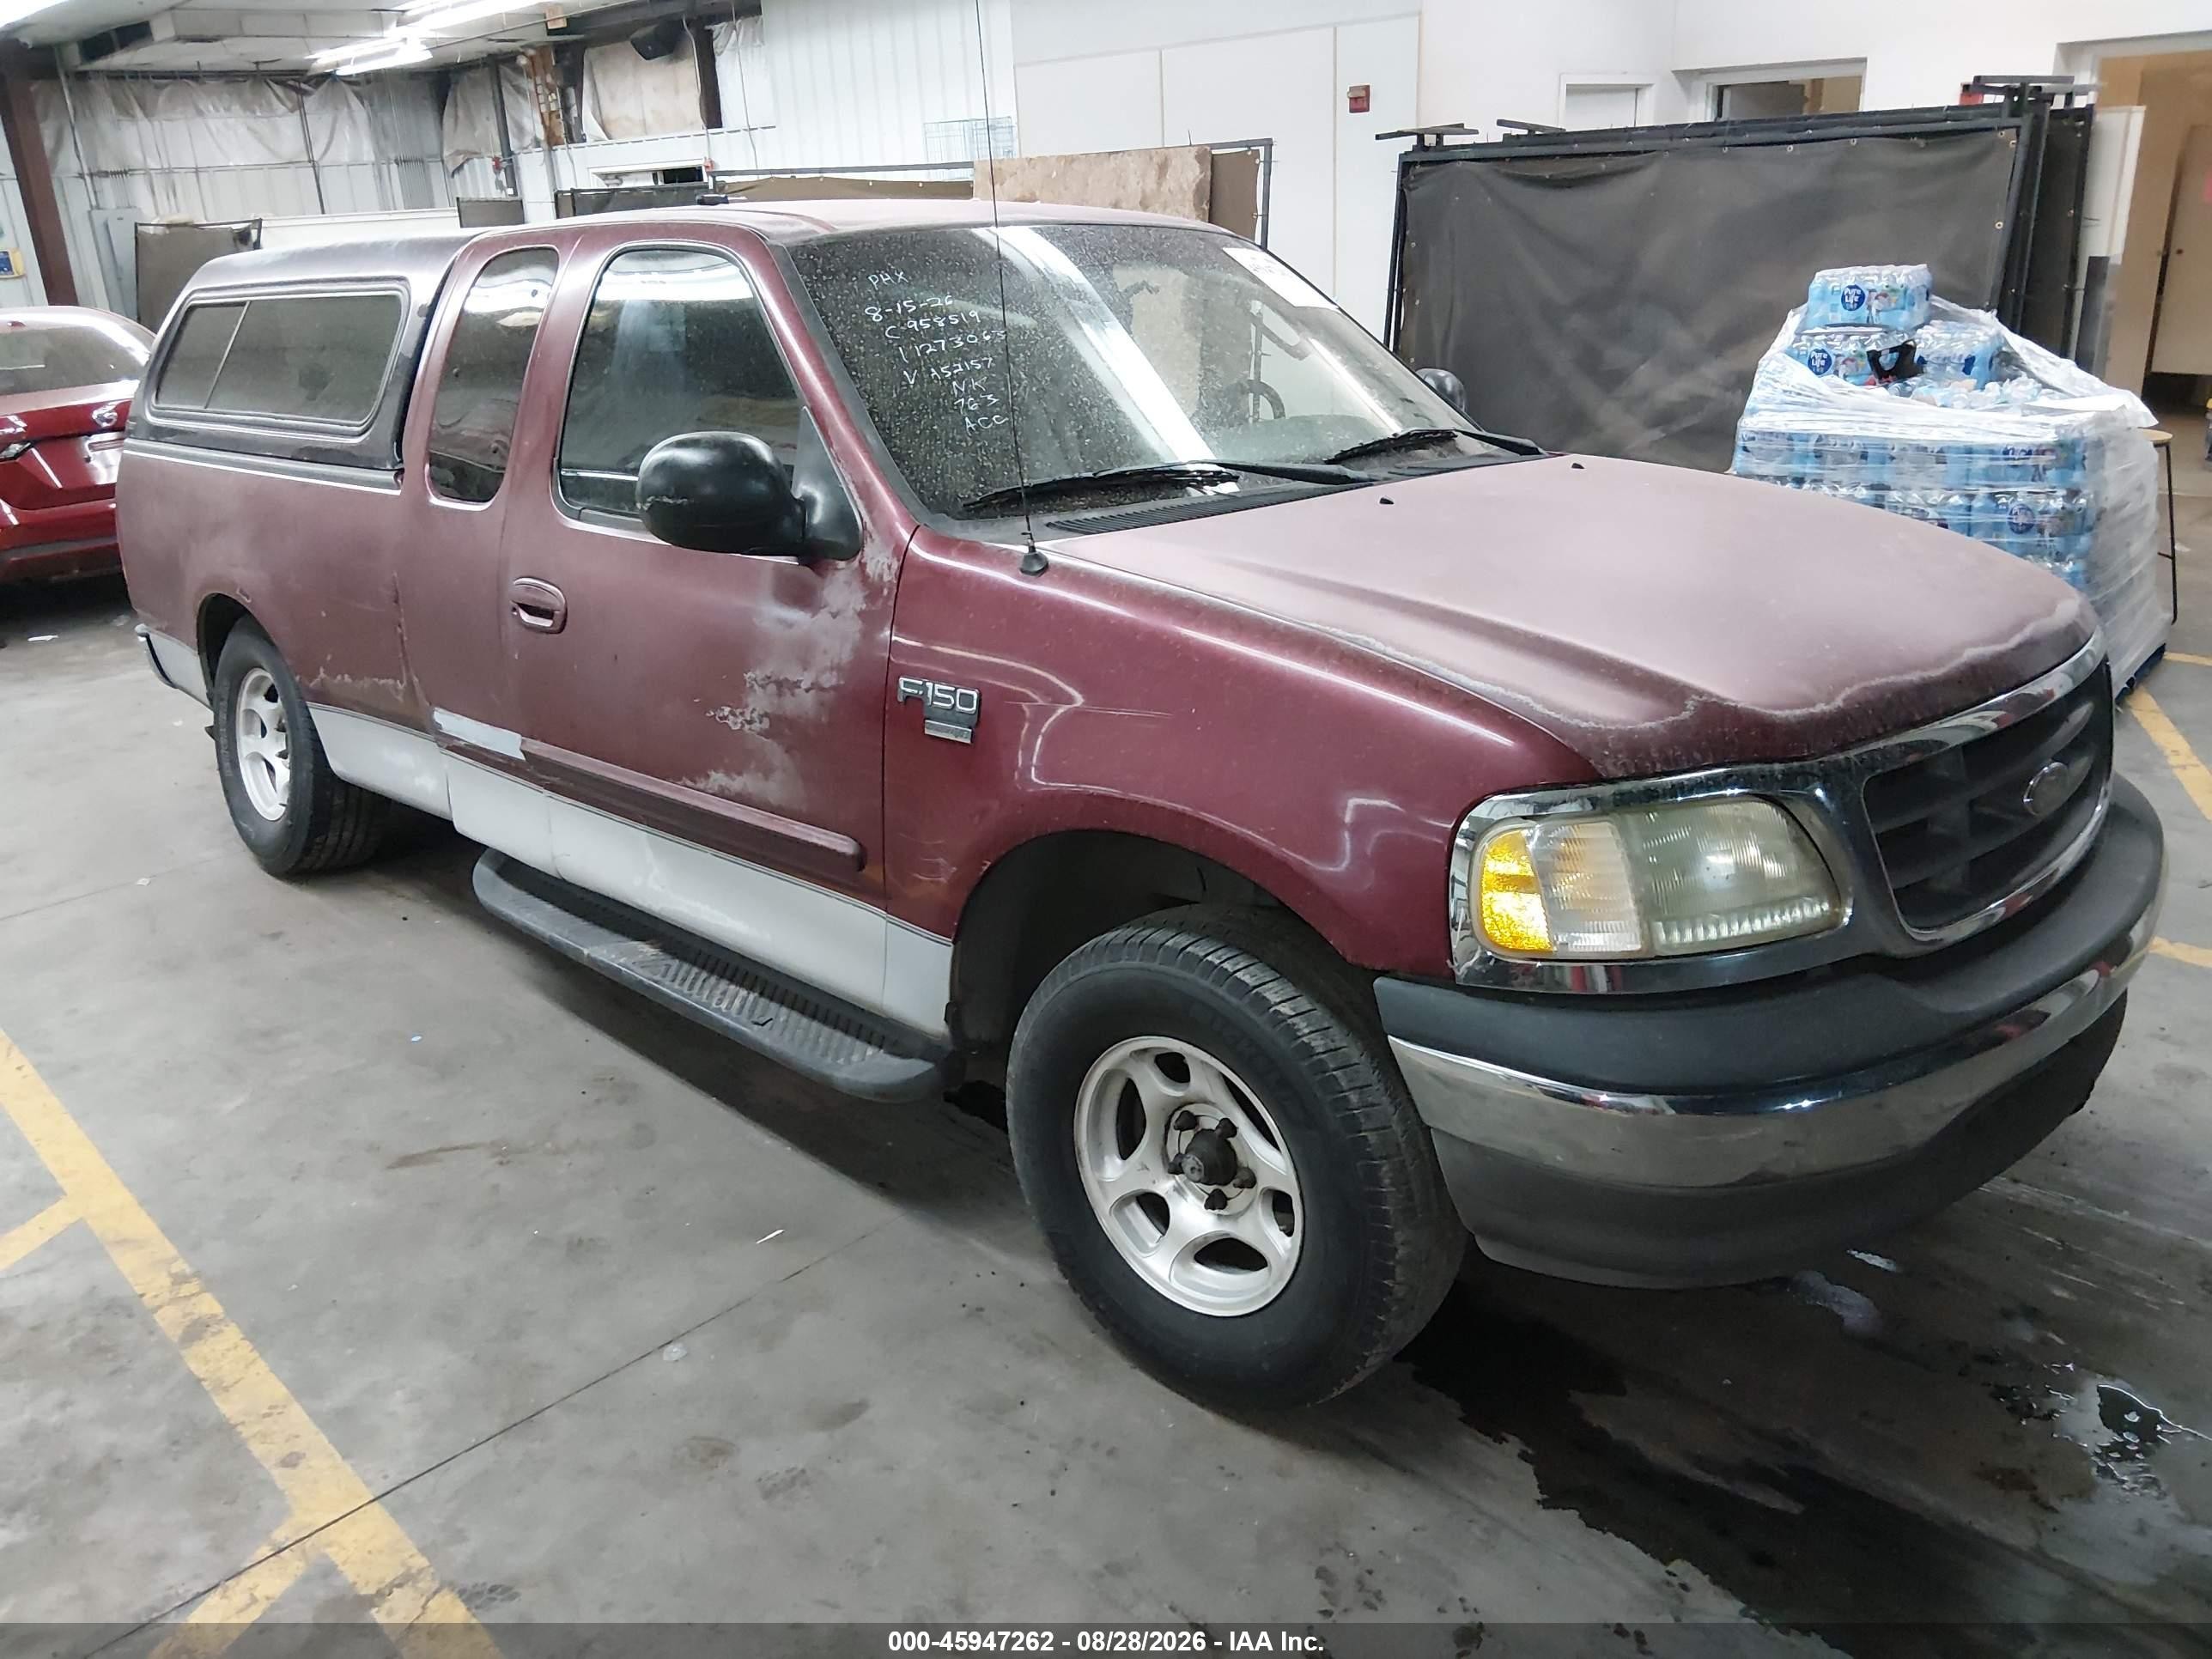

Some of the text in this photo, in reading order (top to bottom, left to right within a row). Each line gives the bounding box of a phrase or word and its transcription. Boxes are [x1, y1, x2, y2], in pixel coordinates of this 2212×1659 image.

[868, 270, 908, 290] PHX
[1844, 287, 1862, 297] Pure
[1844, 295, 1859, 305] Life
[865, 295, 953, 322] 8-15-26
[884, 309, 981, 339] C 958519
[1810, 351, 1828, 361] Pure
[1811, 359, 1826, 368] Life
[903, 369, 918, 385] V
